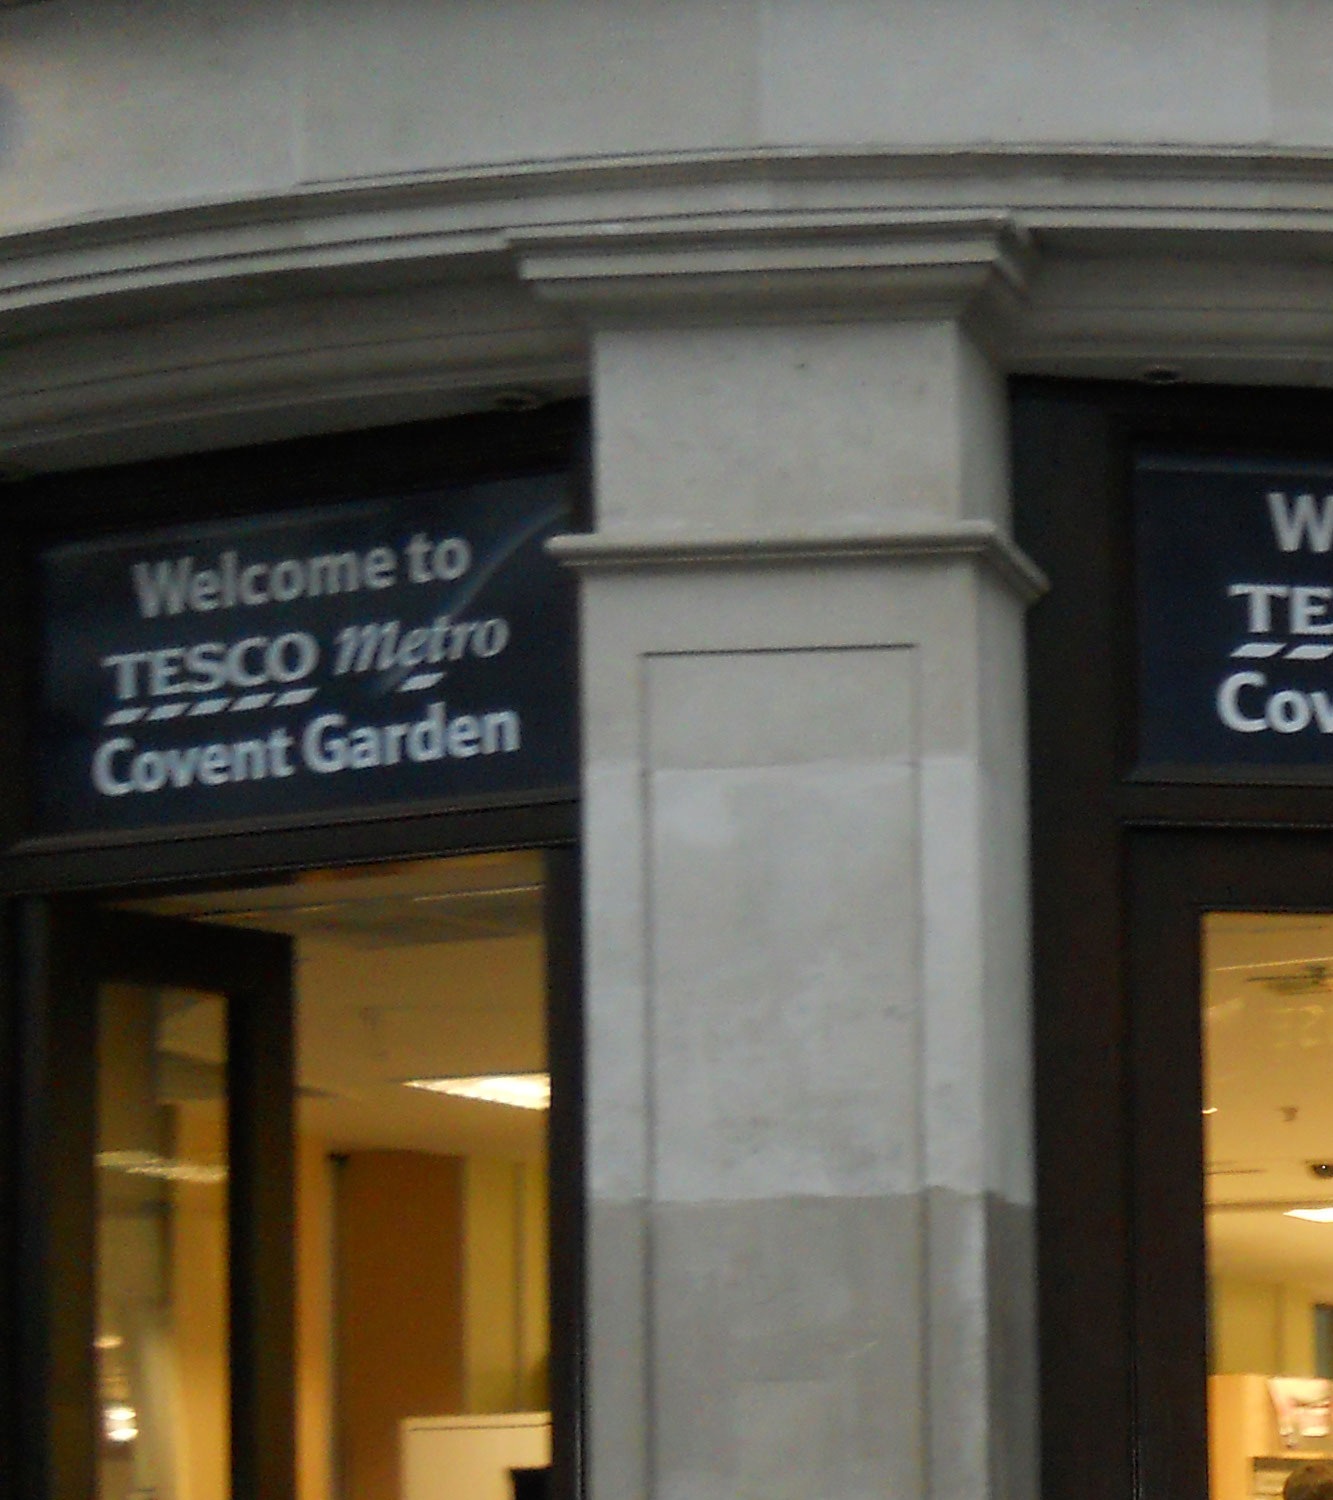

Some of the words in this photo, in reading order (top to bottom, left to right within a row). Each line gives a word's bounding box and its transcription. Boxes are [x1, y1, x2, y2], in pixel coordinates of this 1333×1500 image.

[132, 544, 397, 618] Welcome
[405, 531, 471, 582] to
[102, 631, 319, 701] TESCO
[91, 726, 295, 798] Covent
[303, 702, 521, 774] Garden
